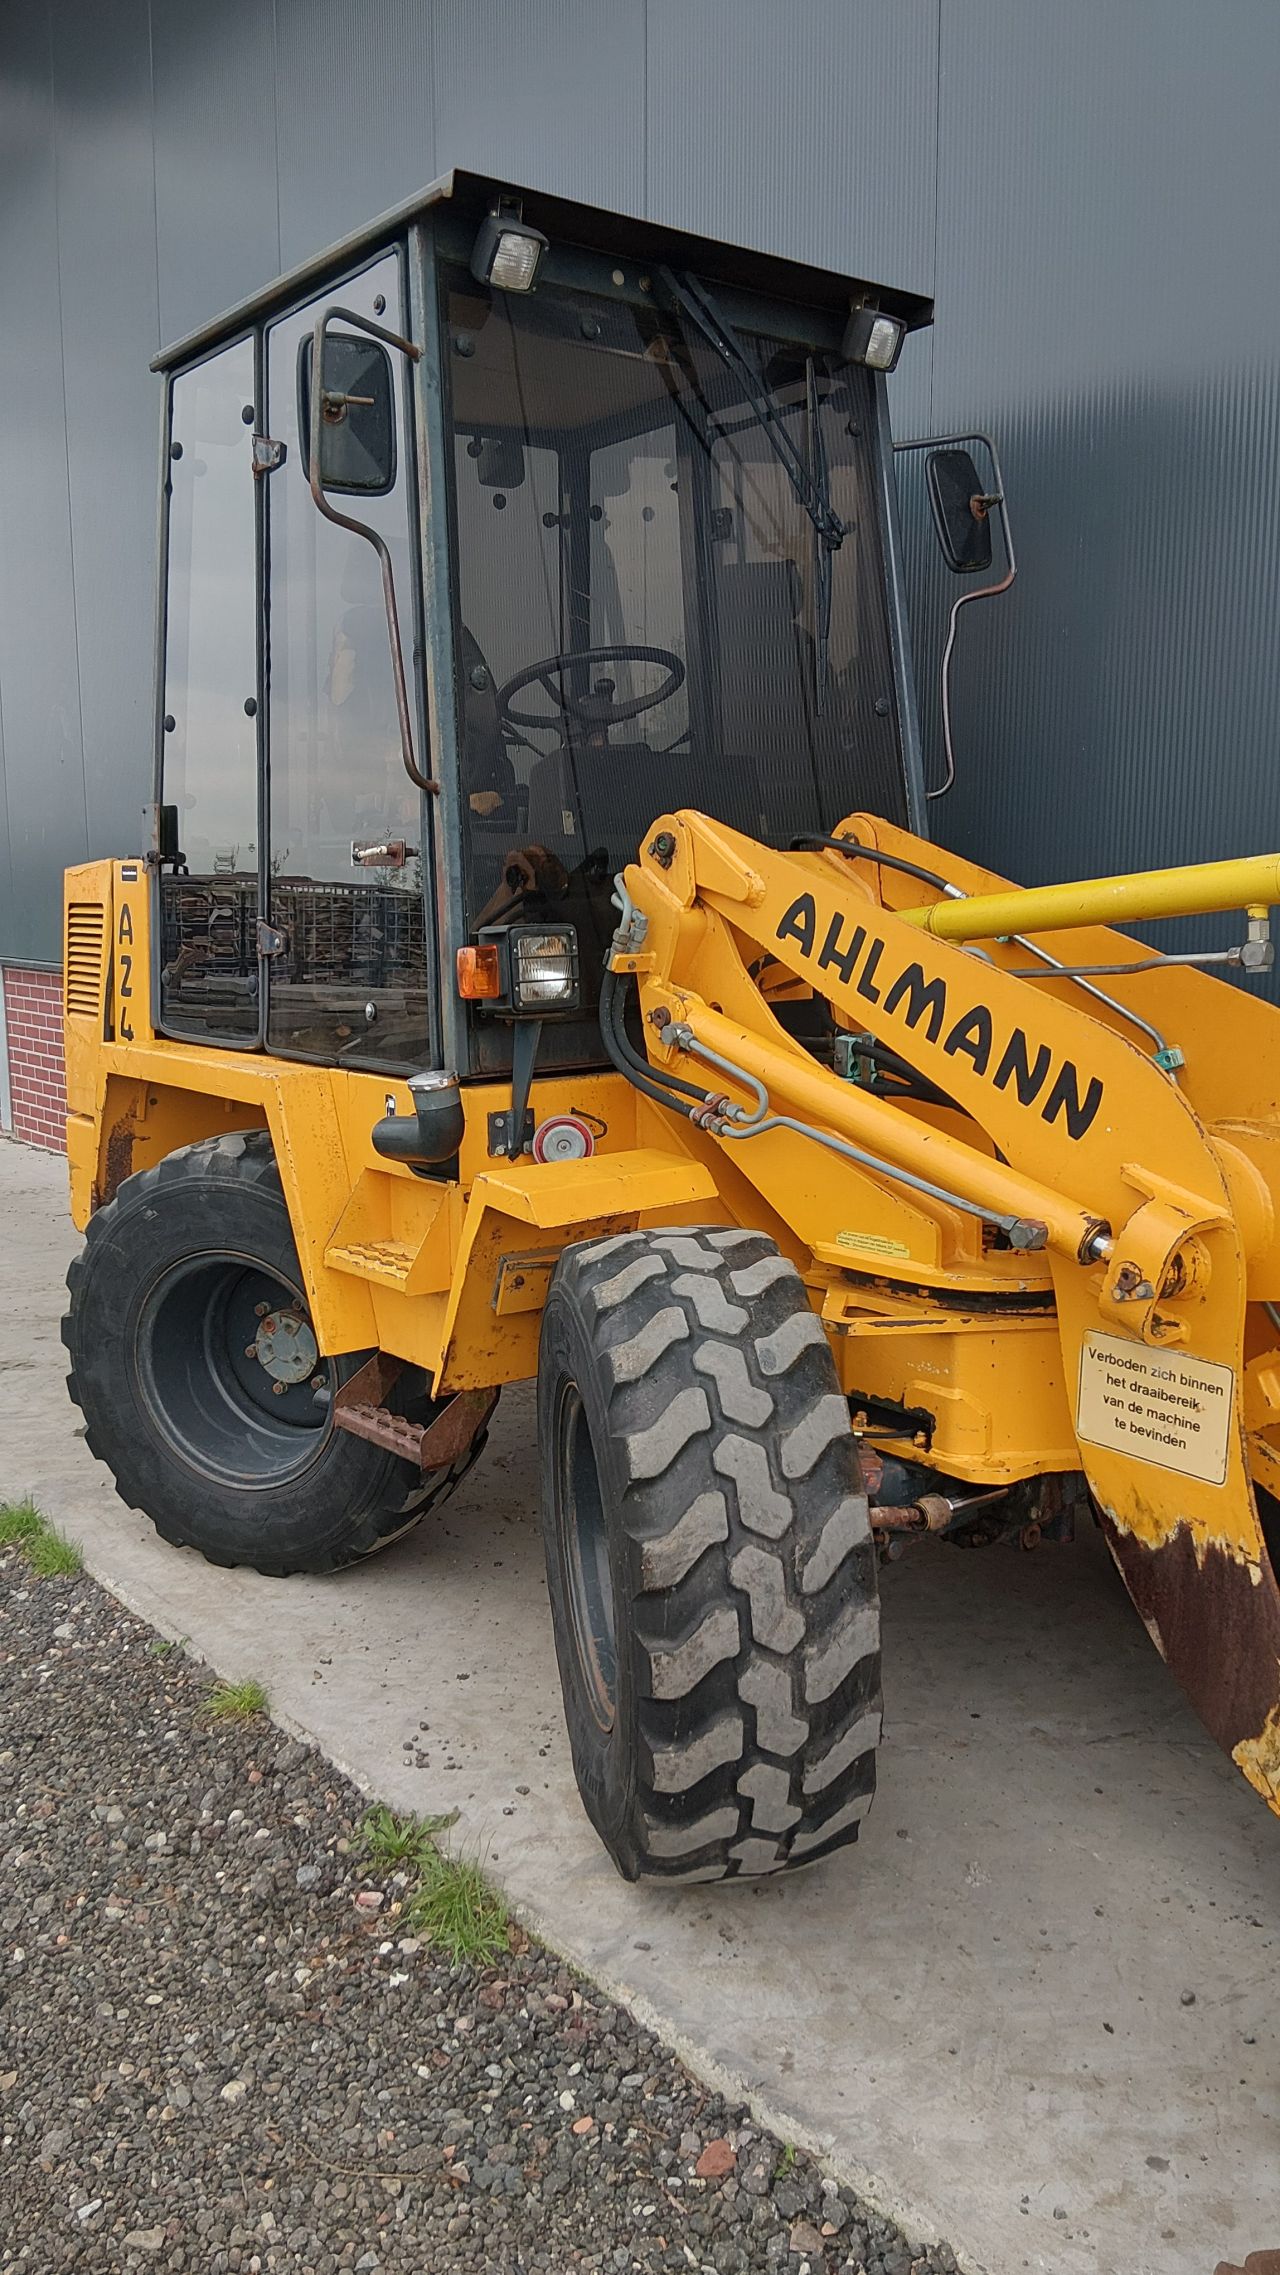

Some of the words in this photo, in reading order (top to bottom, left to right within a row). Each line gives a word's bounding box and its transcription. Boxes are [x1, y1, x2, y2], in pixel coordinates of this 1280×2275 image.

[776, 892, 1104, 1140] AHLMANN
[1088, 1347, 1147, 1375] Verboden
[1150, 1366, 1177, 1383] zich
[1180, 1373, 1224, 1397] binnen
[1106, 1373, 1126, 1390] het
[1129, 1380, 1200, 1410] draaibereik
[1103, 1394, 1125, 1410] van
[1128, 1401, 1143, 1415] de
[1146, 1408, 1201, 1433] machine
[1114, 1416, 1127, 1430] te
[1130, 1421, 1187, 1450] bevinden
